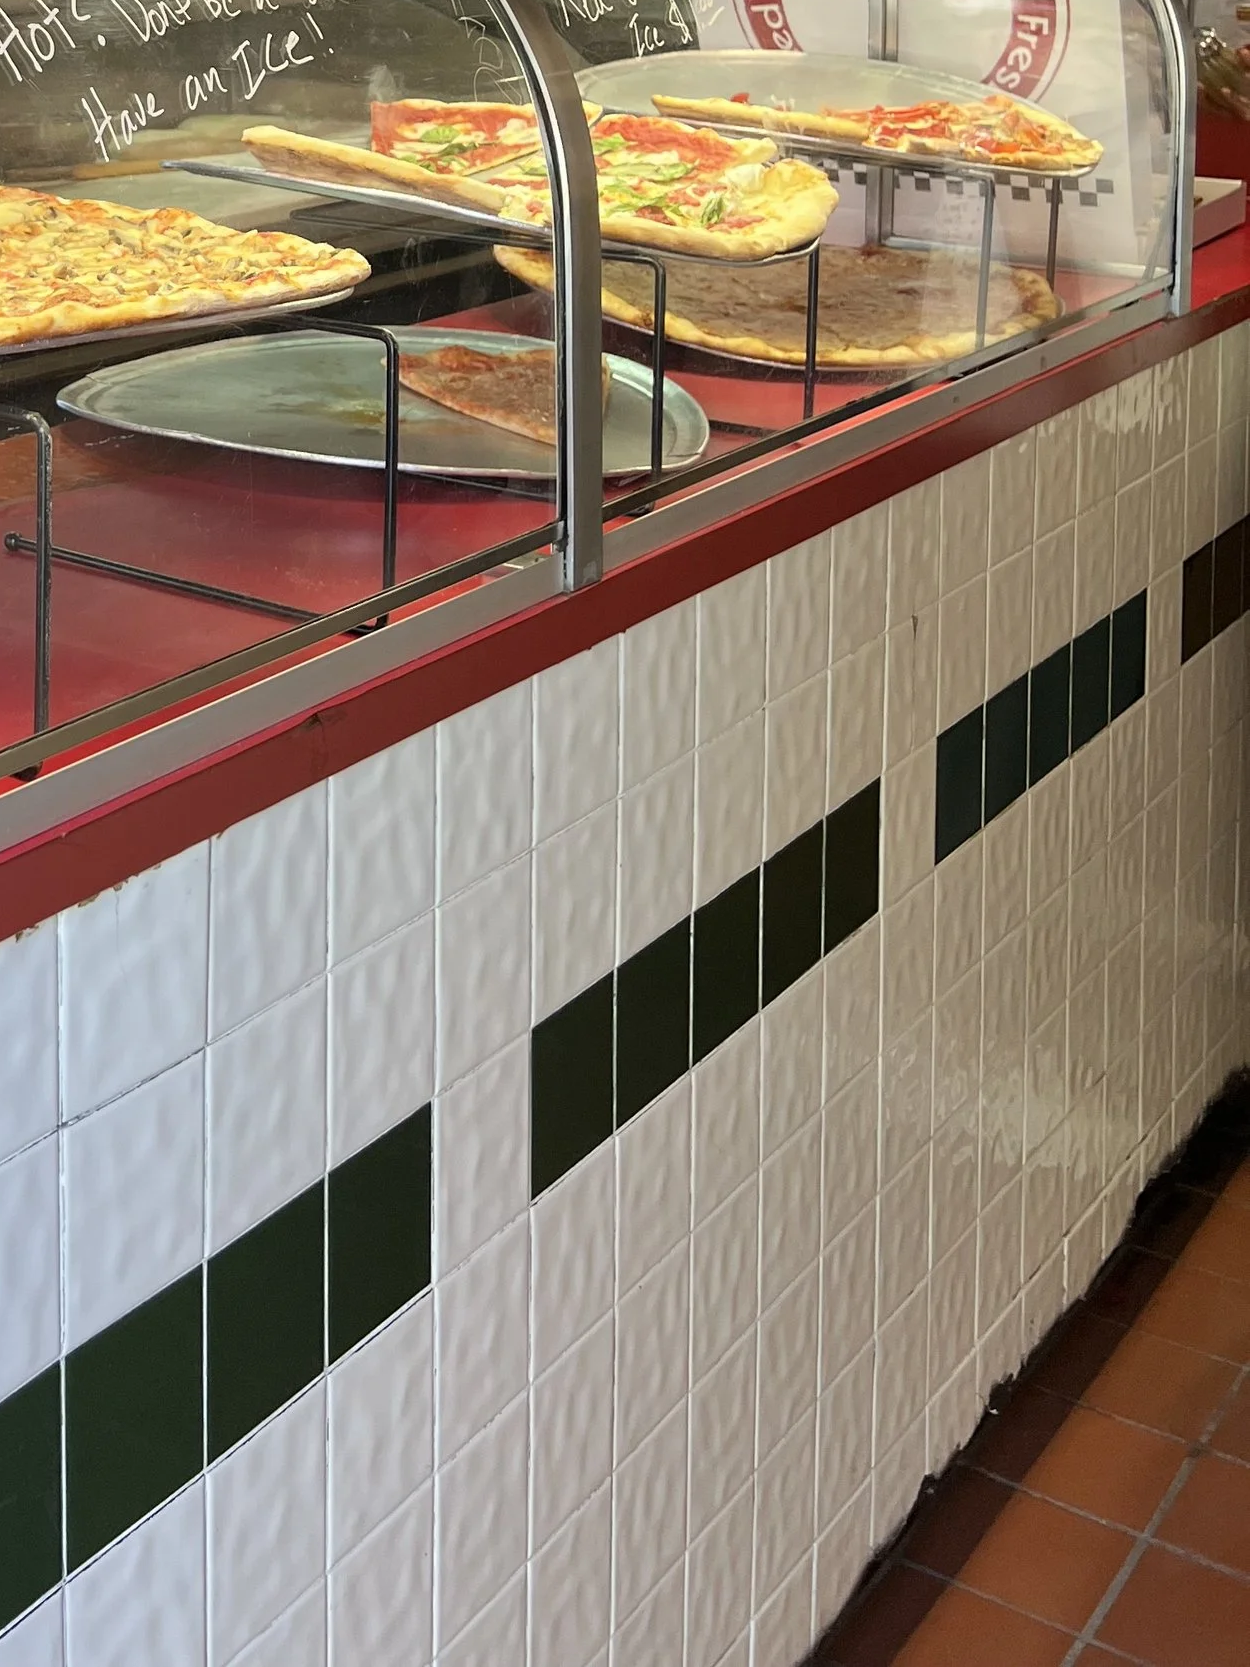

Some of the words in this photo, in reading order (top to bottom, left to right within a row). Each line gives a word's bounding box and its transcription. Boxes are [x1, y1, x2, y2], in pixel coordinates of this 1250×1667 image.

[995, 13, 1050, 95] Fres
[81, 86, 165, 163] Have
[184, 66, 228, 110] an
